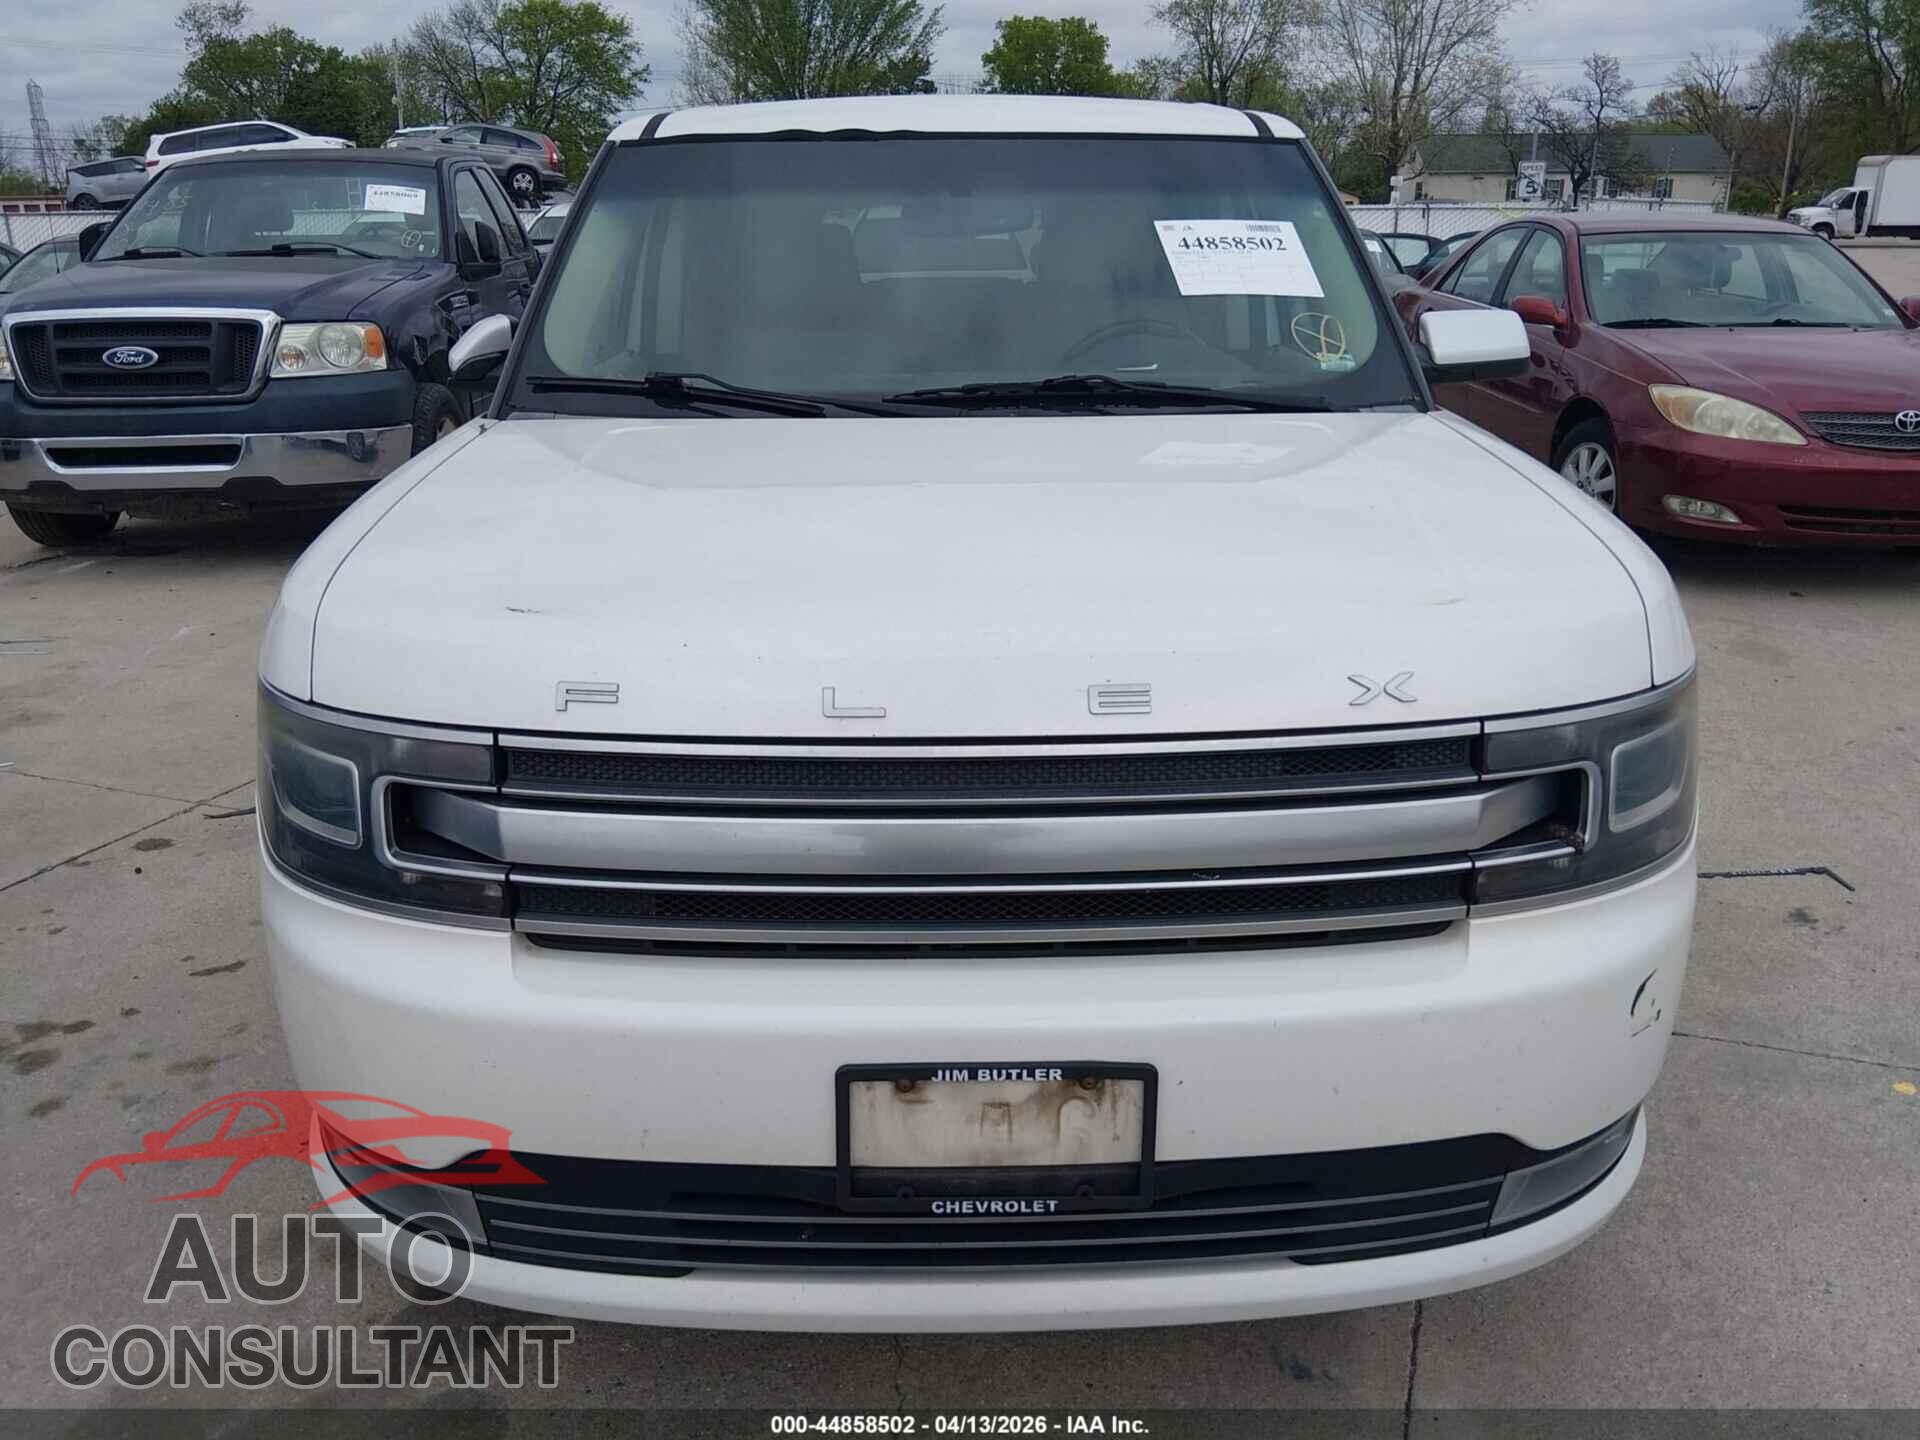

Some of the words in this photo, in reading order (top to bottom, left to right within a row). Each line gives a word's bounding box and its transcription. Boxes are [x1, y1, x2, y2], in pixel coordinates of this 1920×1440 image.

[1177, 236, 1288, 251] 44858502
[114, 350, 145, 364] Ford
[555, 670, 1418, 719] FLEX
[931, 1069, 969, 1083] JIM
[976, 1068, 1063, 1082] BUTLER
[931, 1200, 1059, 1214] CHEVROLET
